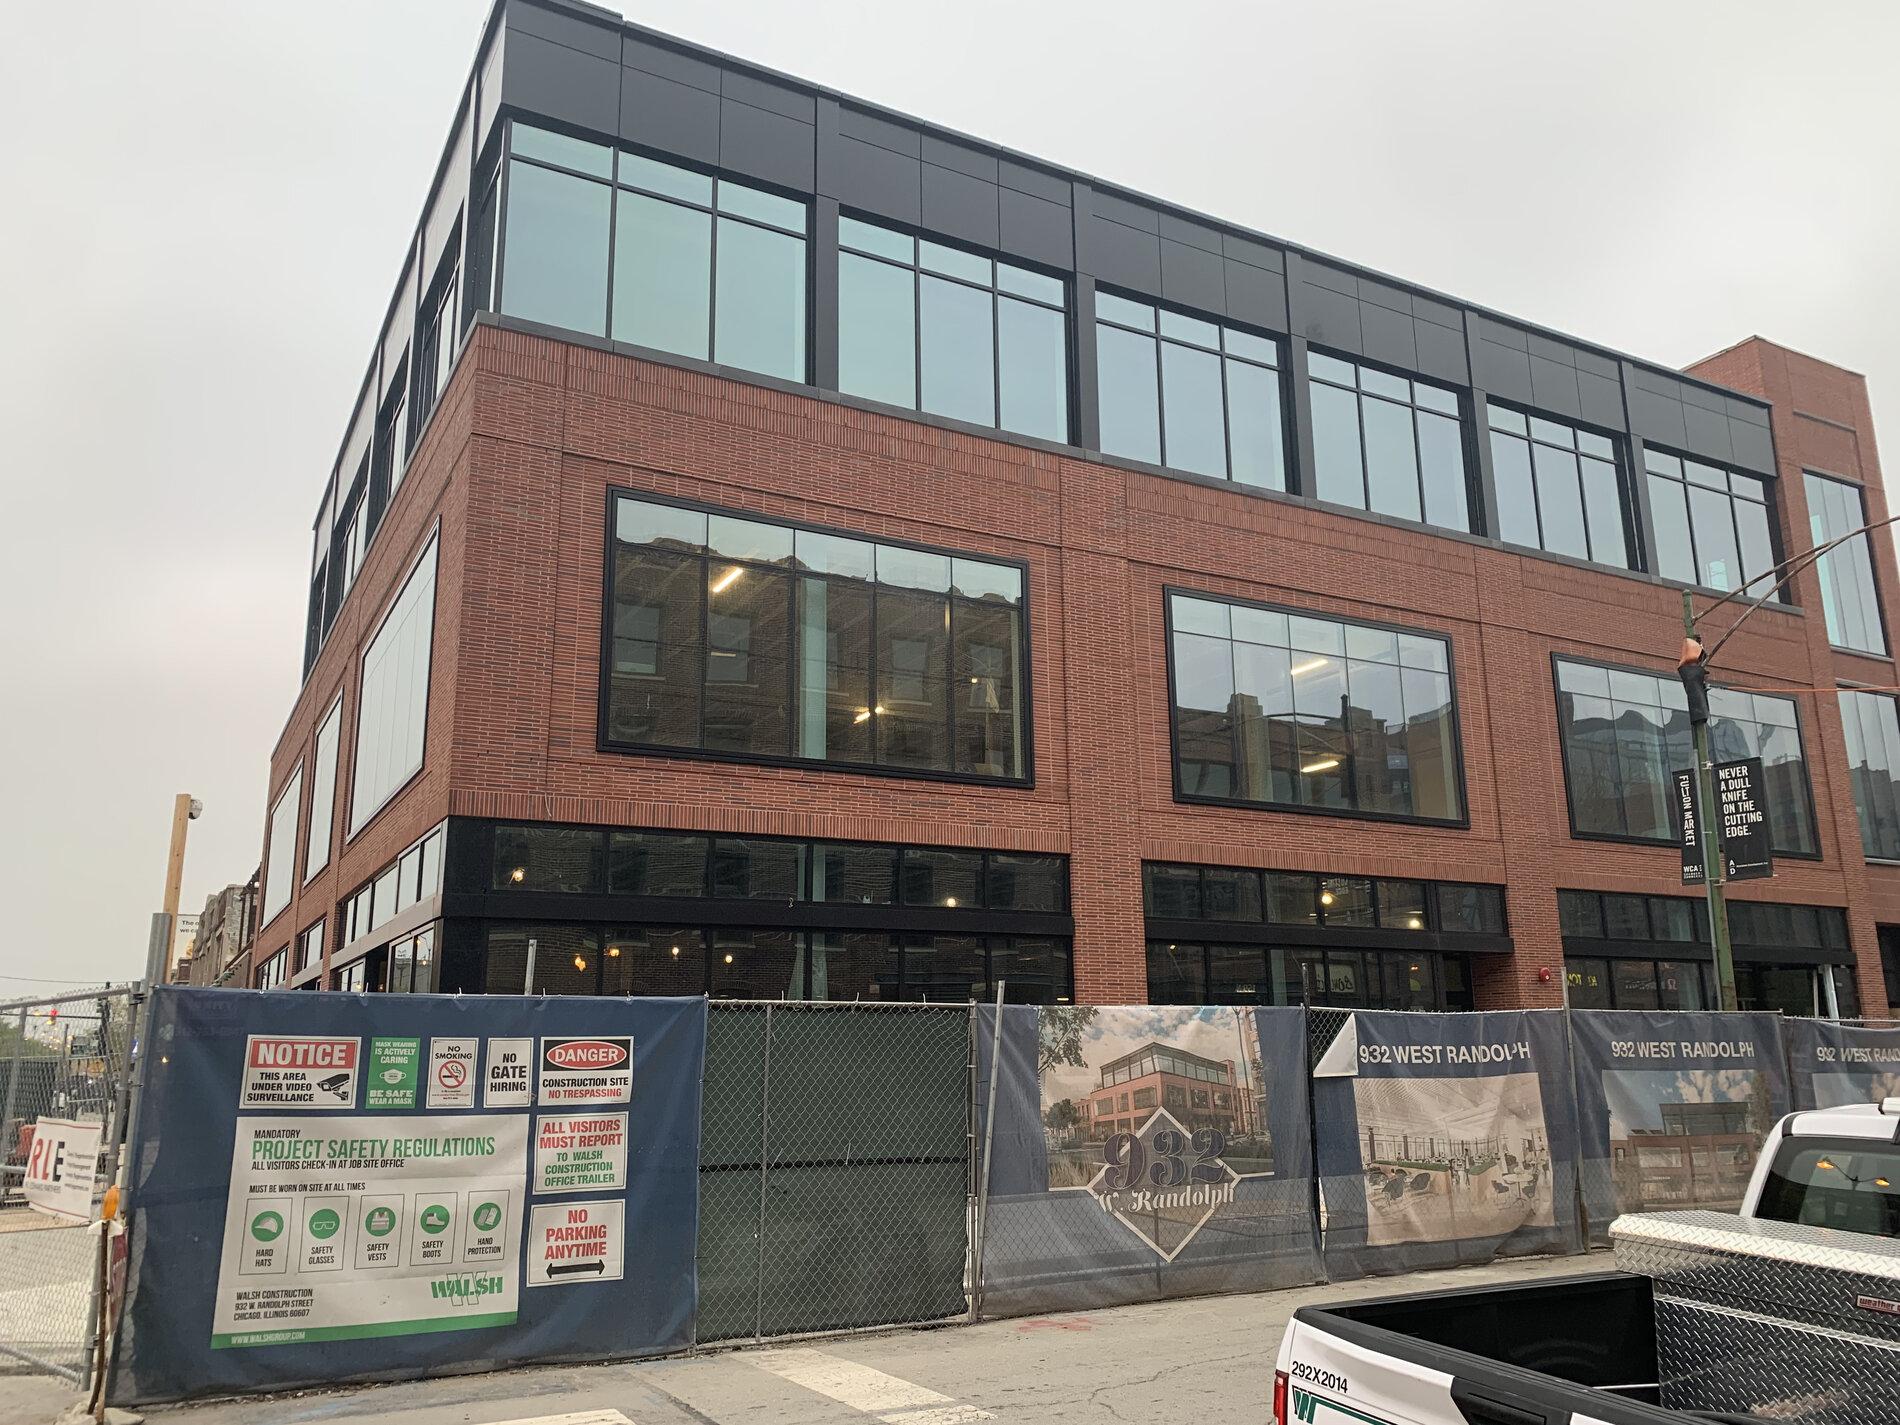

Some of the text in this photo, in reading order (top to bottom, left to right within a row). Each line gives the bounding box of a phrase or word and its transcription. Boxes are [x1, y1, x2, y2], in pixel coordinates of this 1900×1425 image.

[1719, 765, 1749, 780] NEVER
[1721, 777, 1752, 791] A DULL
[1722, 789, 1748, 803] KNIFE
[1679, 775, 1696, 847] FULTON MARKET
[1723, 800, 1756, 815] ON THE
[1724, 811, 1763, 827] CUTTING
[1726, 825, 1752, 838] EDGE.
[258, 1043, 346, 1066] NOTICE
[384, 1048, 416, 1056] ACTIVELY
[554, 1048, 620, 1063] DANGER
[1359, 1041, 1531, 1064] 932 WEST RANDOLPH
[1611, 1041, 1755, 1058] 932 WEST RANDOLPH
[1817, 1047, 1836, 1062] 932
[1840, 1047, 1872, 1062] WEST
[380, 1056, 408, 1064] CARING
[503, 1053, 517, 1063] NO
[259, 1072, 306, 1081] THIS AREA
[491, 1066, 527, 1079] GATE
[251, 1083, 312, 1091] UNDER VIDEO
[490, 1082, 526, 1092] HIRING
[542, 1078, 629, 1088] CONSTRUCTION SITE
[246, 1092, 314, 1102] SURVEILLANCE
[385, 1090, 413, 1098] SAFE
[548, 1089, 622, 1099] NO TRESPASSING
[543, 1119, 621, 1134] ALL VISITORS
[254, 1129, 300, 1139] MANDATORY
[539, 1133, 623, 1149] MUST REPORT
[252, 1136, 495, 1160] PROJECT SAFETY REGULATIONS
[28, 1138, 65, 1182] RLE
[556, 1150, 603, 1162] TO WALSH
[1103, 1128, 1226, 1190] 932
[251, 1158, 405, 1170] ALL VISITORS CHECK-IN AT JOB SITE OFFICE
[545, 1161, 613, 1175] CONSTRUCTION
[544, 1173, 615, 1187] OFFICE TRAILER
[249, 1182, 366, 1193] MUST BE WORN ON SITE AT ALL TIMES
[1127, 1182, 1234, 1212] Randolph
[567, 1209, 588, 1224] NO
[545, 1224, 607, 1242] PARKING
[421, 1240, 444, 1249] SAFETY
[477, 1237, 493, 1245] HAND
[256, 1249, 274, 1257] HARD
[311, 1246, 334, 1255] SAFETY
[366, 1243, 390, 1252] SAFETY
[422, 1249, 442, 1258] BOOTS
[467, 1246, 501, 1255] PROTECTION
[544, 1241, 607, 1260] ANYTIME
[255, 1259, 272, 1267] HATS
[308, 1256, 335, 1264] GLASSES
[368, 1253, 387, 1261] VESTS
[430, 1277, 503, 1298] WALSH
[236, 1289, 313, 1300] WALSH CONSTRUCTION
[235, 1299, 313, 1310] 932 W. RANDOLPH STREET
[1859, 1297, 1894, 1309] weather
[263, 1310, 288, 1319] ILLINOIS
[289, 1309, 310, 1318] 60607
[231, 1331, 305, 1345] WWW.WALSHGROUP.COM
[1291, 1360, 1348, 1394] 292X2014
